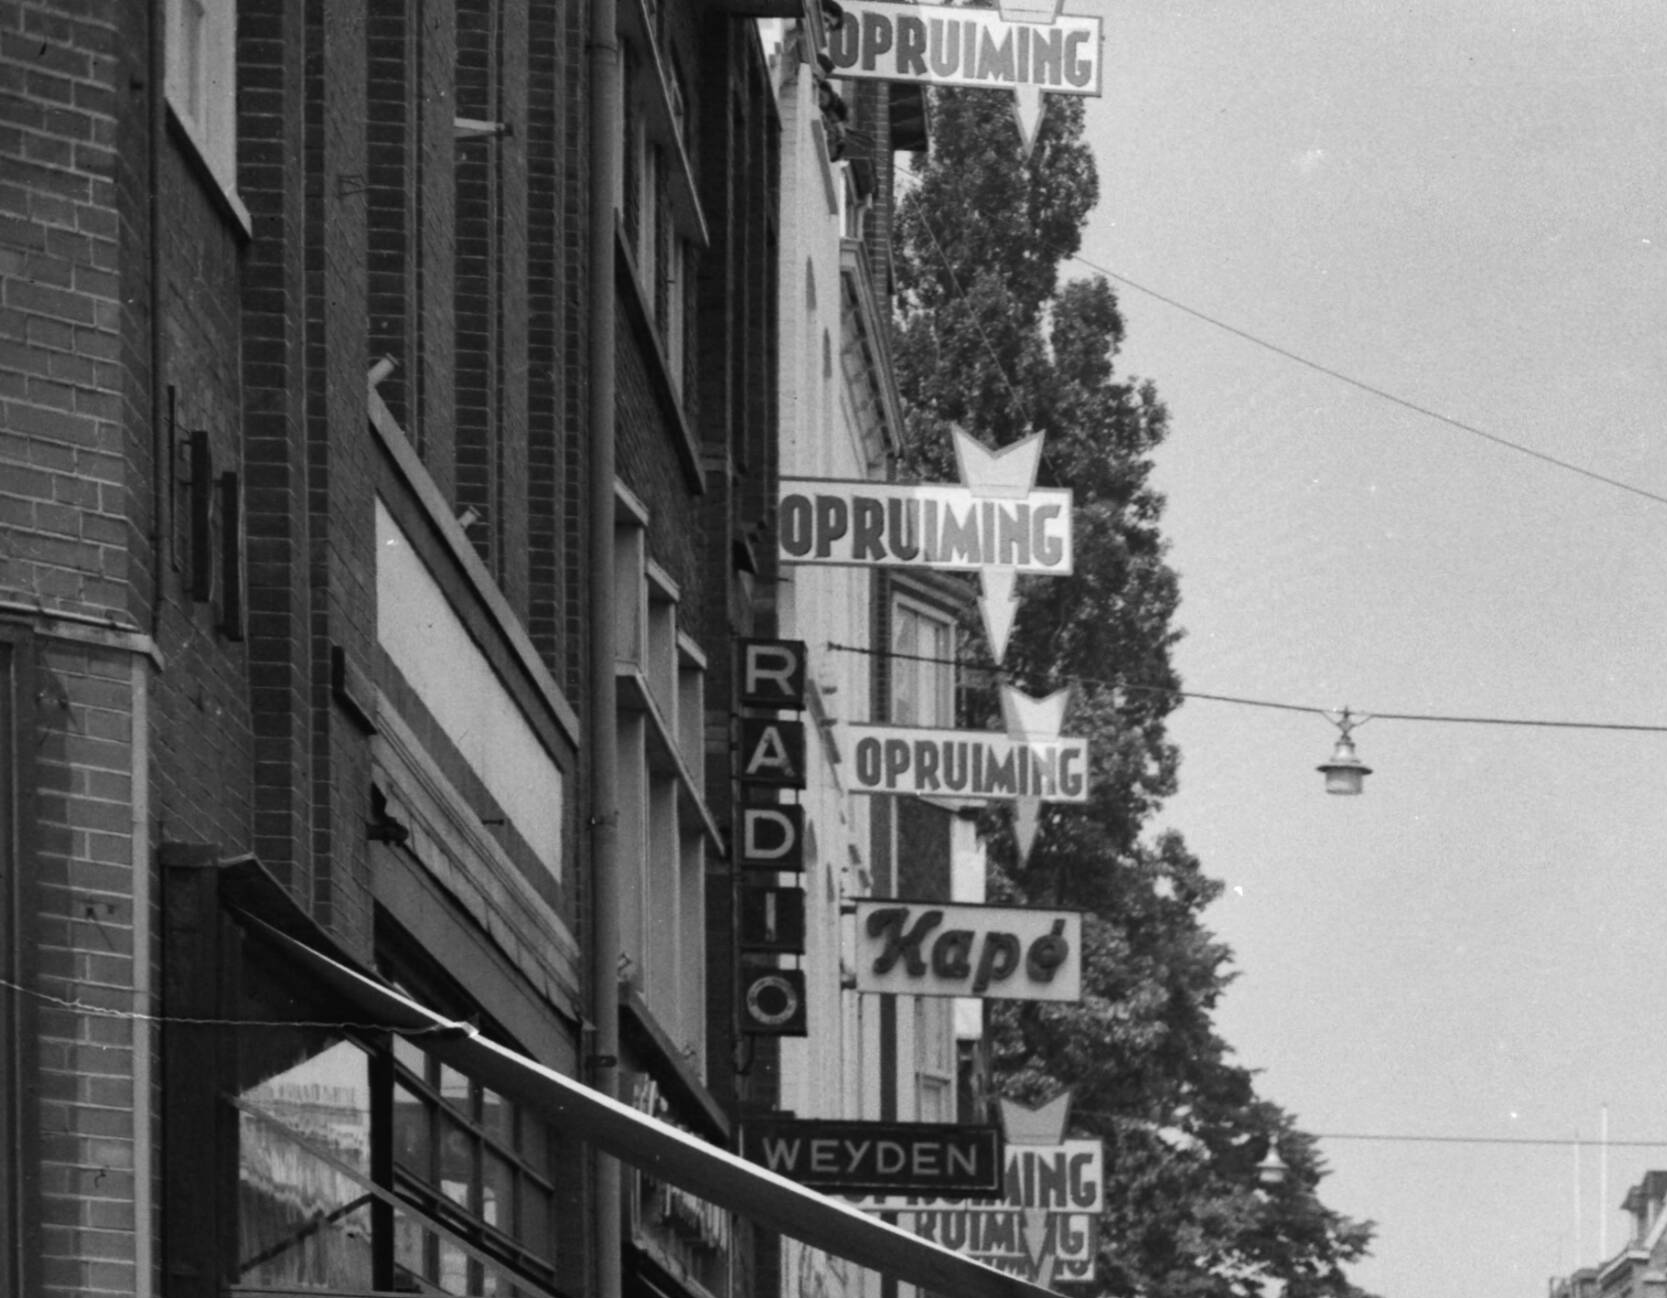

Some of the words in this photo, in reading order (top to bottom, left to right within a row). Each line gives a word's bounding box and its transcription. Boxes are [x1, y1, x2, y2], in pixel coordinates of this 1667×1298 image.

[827, 12, 1092, 88] OPRUIMING
[780, 495, 1062, 567] OPRUIMING
[855, 736, 1084, 797] OPRUIMING
[745, 645, 798, 1026] RADIO
[867, 907, 1069, 992] Kapé
[763, 1140, 977, 1177] WEYDEN
